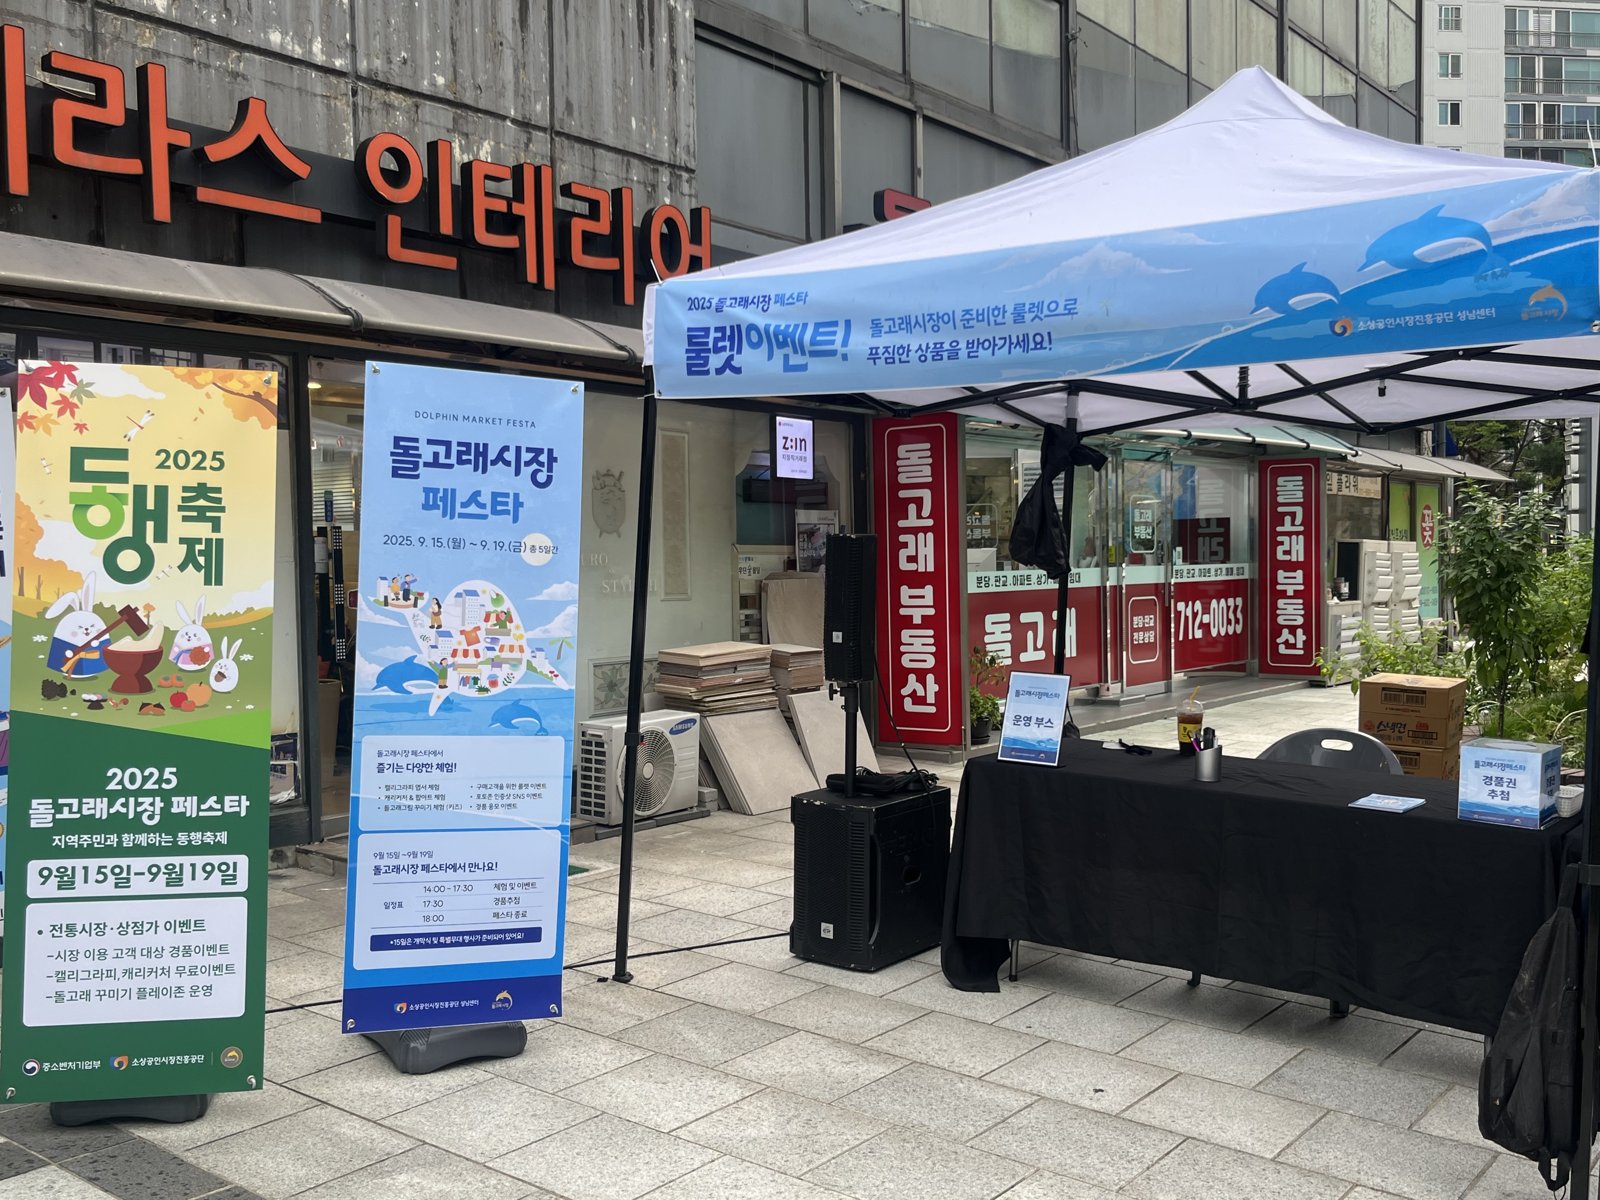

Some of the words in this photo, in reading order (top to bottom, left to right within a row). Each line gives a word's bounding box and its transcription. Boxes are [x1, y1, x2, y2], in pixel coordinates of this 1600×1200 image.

[356, 132, 711, 305] 인테리어
[686, 296, 713, 312] 2025
[714, 293, 772, 313] 돌고래시장
[774, 291, 808, 306] 페스타
[868, 310, 957, 339] 돌고래시장이
[959, 305, 1008, 332] 준비한
[1010, 298, 1078, 325] 룰렛으로
[1358, 312, 1454, 332] 소상공인시장진흥공단
[1457, 307, 1496, 321] 성남센터
[685, 318, 852, 376] 룰렛이벤트!
[866, 344, 911, 366] 푸짐한
[914, 340, 962, 363] 상품을
[964, 331, 1053, 359] 받아가세요!
[414, 410, 459, 423] DOLPHIN
[462, 415, 503, 427] MARKET
[506, 419, 537, 429] FESTA
[155, 448, 226, 472] 2025
[390, 436, 558, 489] 돌고래시장
[421, 486, 524, 524] 페스타
[896, 442, 935, 572] 돌고래
[69, 446, 169, 585] 동행
[1276, 475, 1305, 562] 돌고래
[177, 482, 227, 587] 축제
[1134, 525, 1152, 539] 부동산
[383, 534, 414, 548] 2025.
[529, 543, 537, 555] 총
[538, 544, 559, 556] 5일간
[1177, 597, 1243, 641] 712-0033
[1275, 569, 1306, 655] 부동산
[899, 584, 939, 713] 부동산
[1012, 714, 1032, 727] 운영
[1034, 716, 1054, 729] 부스
[1376, 720, 1407, 734] 스낵면
[377, 750, 410, 758] 돌고래시장
[411, 749, 444, 757] 페스타에서
[376, 762, 404, 774] 즐기는
[406, 762, 434, 773] 다양한
[435, 762, 457, 773] 체험!
[105, 767, 178, 790] 2025
[1482, 775, 1517, 789] 경품권
[1487, 789, 1510, 801] 추첨
[29, 797, 164, 828] 돌고래시장
[171, 795, 250, 818] 페스타
[52, 834, 119, 849] 지역주민과
[122, 832, 174, 848] 함께하는
[176, 831, 228, 846] 동행축제
[374, 852, 385, 860] 9월
[386, 851, 400, 859] 15일
[419, 850, 434, 859] 19일
[373, 864, 419, 876] 돌고래시장
[420, 862, 466, 873] 페스타에서
[468, 861, 498, 873] 만나요!
[423, 885, 445, 893] 14:00
[453, 884, 474, 892] 17:30
[493, 882, 508, 891] 체험
[509, 882, 516, 890] 및
[517, 881, 538, 890] 이벤트
[383, 901, 404, 909] 일정표
[423, 900, 444, 908] 17:30
[422, 914, 444, 922] 18:00
[492, 911, 513, 919] 페스타
[514, 910, 528, 919] 종료
[164, 918, 207, 934] 이벤트
[83, 947, 109, 962] 이용
[112, 946, 137, 961] 고객
[140, 945, 165, 960] 대상
[168, 943, 230, 958] 경품이벤트
[174, 963, 236, 979] 무료이벤트
[94, 986, 132, 1002] 꾸미기
[136, 985, 186, 1001] 플레이존
[188, 984, 213, 999] 운영
[43, 1060, 101, 1072] 중소벤처기업부
[132, 1054, 205, 1067] 소상공인시장진흥공단
